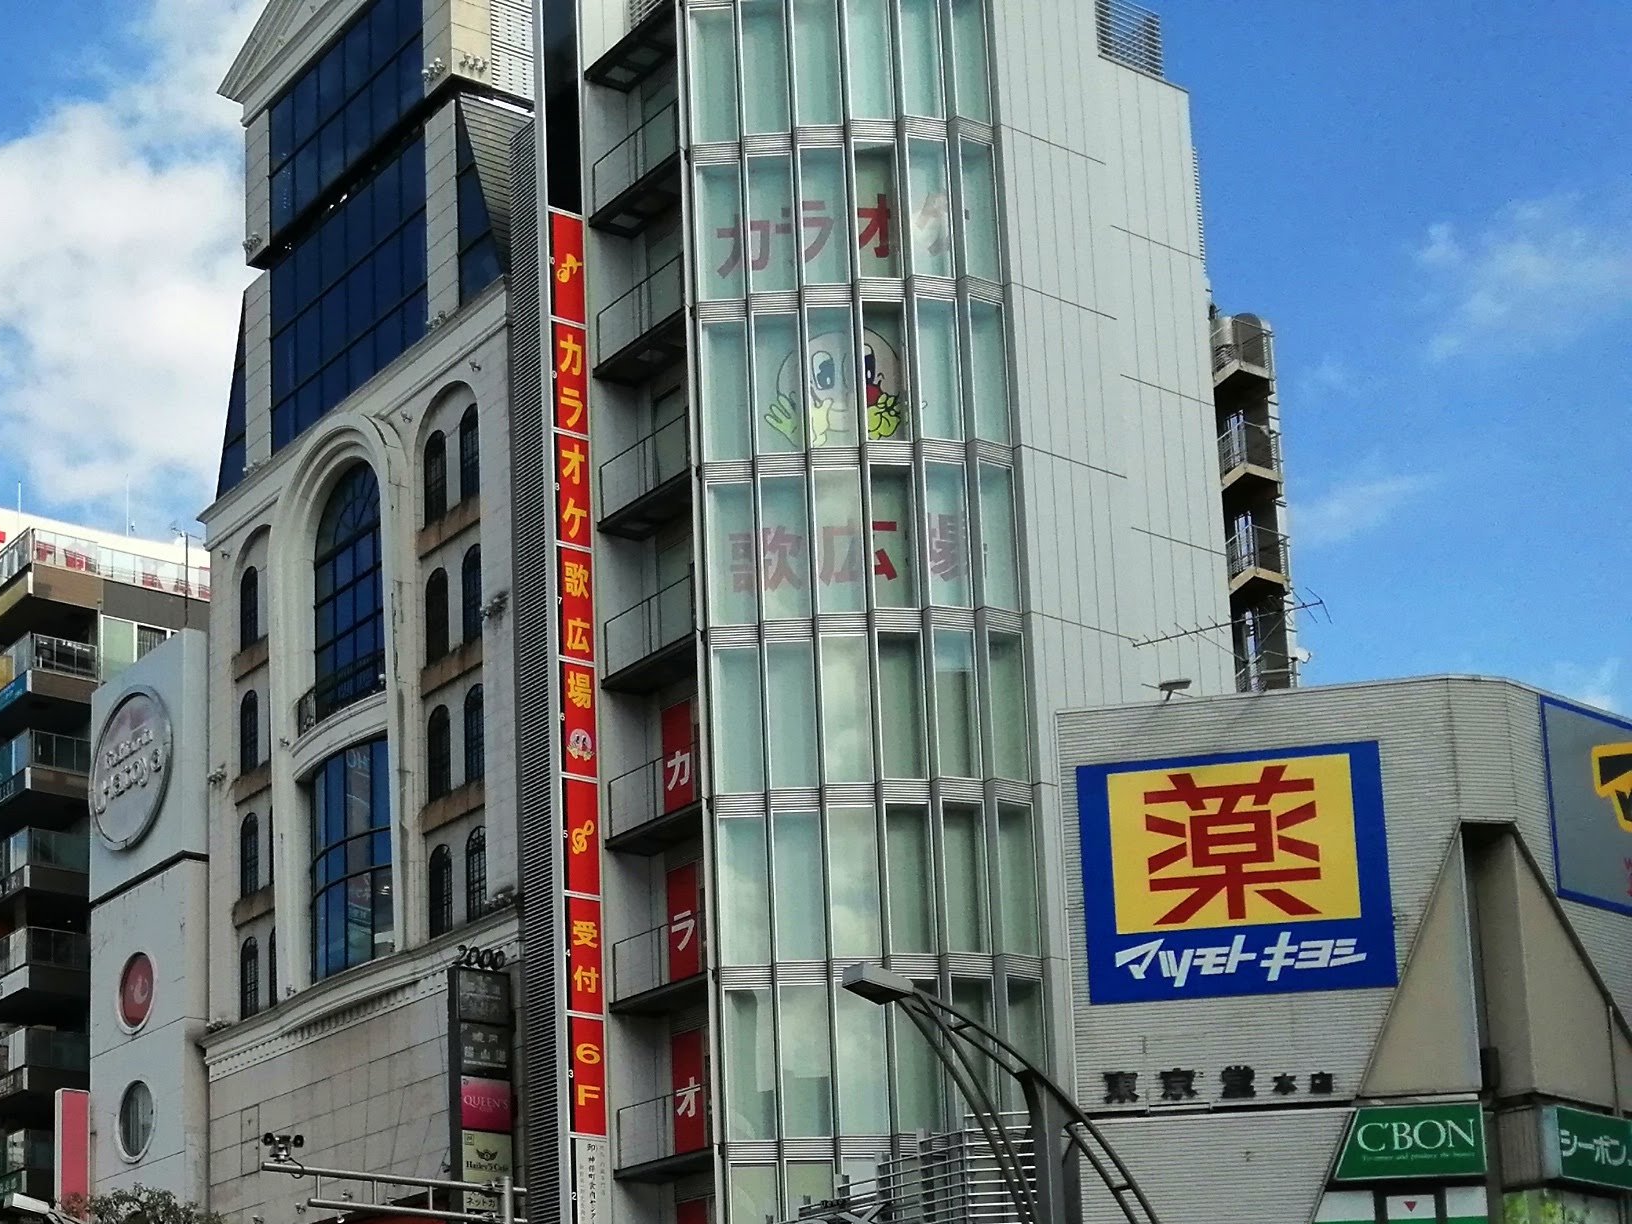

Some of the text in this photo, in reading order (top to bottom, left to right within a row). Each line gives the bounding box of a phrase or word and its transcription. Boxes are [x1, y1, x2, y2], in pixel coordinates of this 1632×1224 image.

[558, 333, 593, 711] カラオケ歌広場
[1144, 764, 1323, 926] 薬
[1114, 931, 1367, 988] マツモトキヨシ
[1357, 1118, 1475, 1152] C'BON
[466, 1196, 496, 1208] ネットカ
